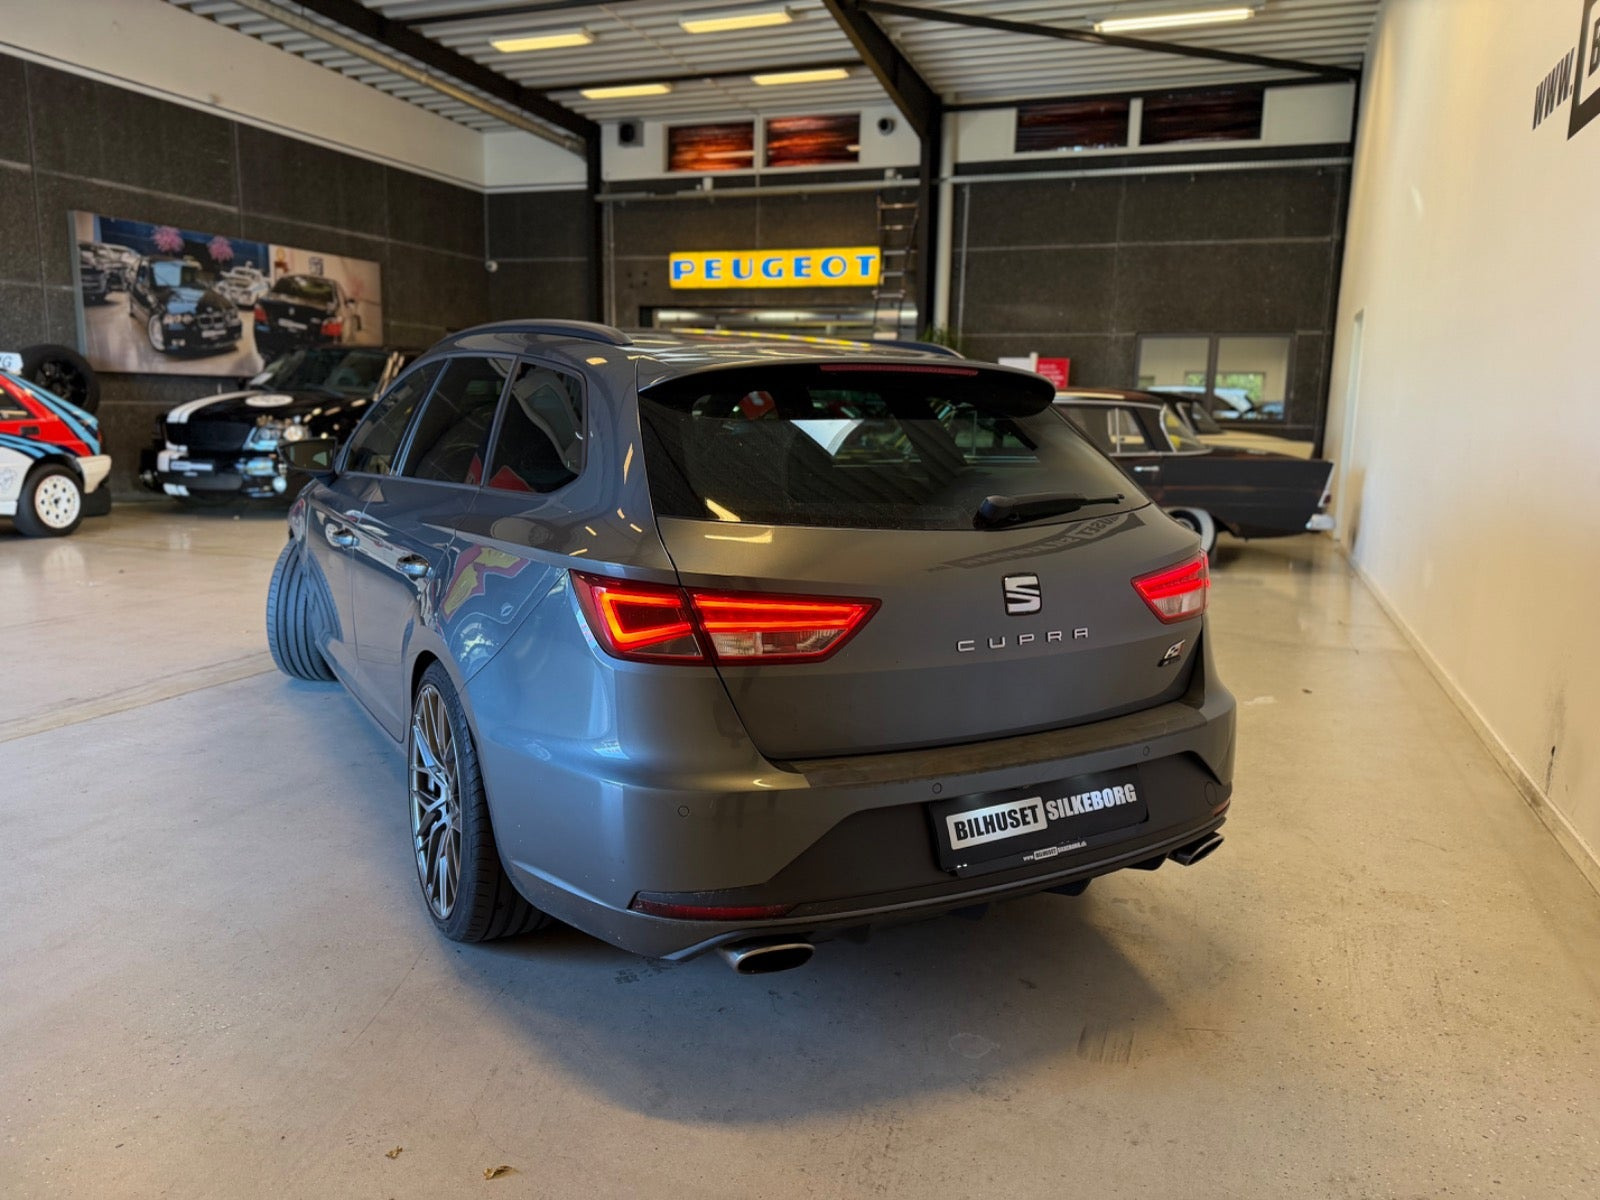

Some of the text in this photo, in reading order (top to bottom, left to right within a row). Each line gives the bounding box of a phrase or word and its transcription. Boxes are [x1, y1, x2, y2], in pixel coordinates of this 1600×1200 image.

[672, 255, 877, 281] PEUGEOT
[956, 627, 1090, 652] CUPRA
[954, 783, 1137, 841] BILHUSET SILKEBORG
